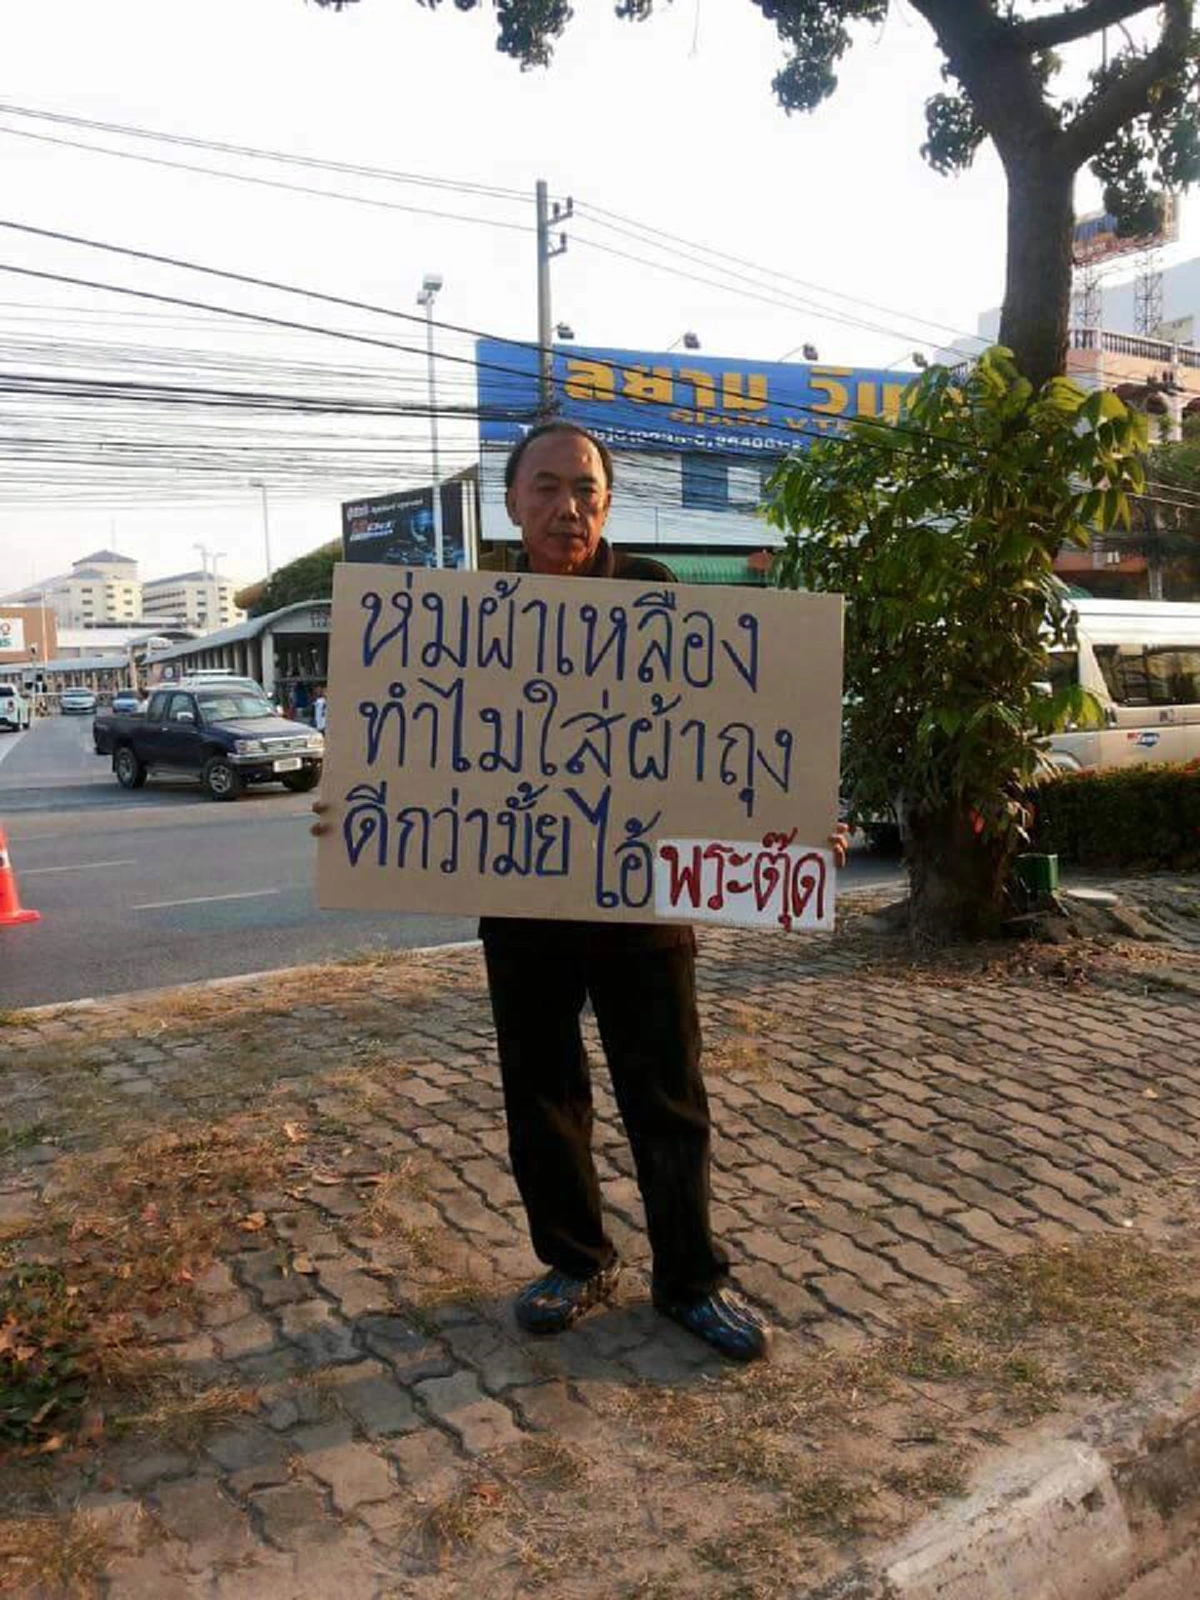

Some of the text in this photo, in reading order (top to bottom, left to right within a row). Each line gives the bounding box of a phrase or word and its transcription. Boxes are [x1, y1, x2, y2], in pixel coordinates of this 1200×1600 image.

[360, 572, 759, 693] ห่มผ้าเหลือง
[359, 677, 794, 817] ทำไมใส่ผ้าถุง
